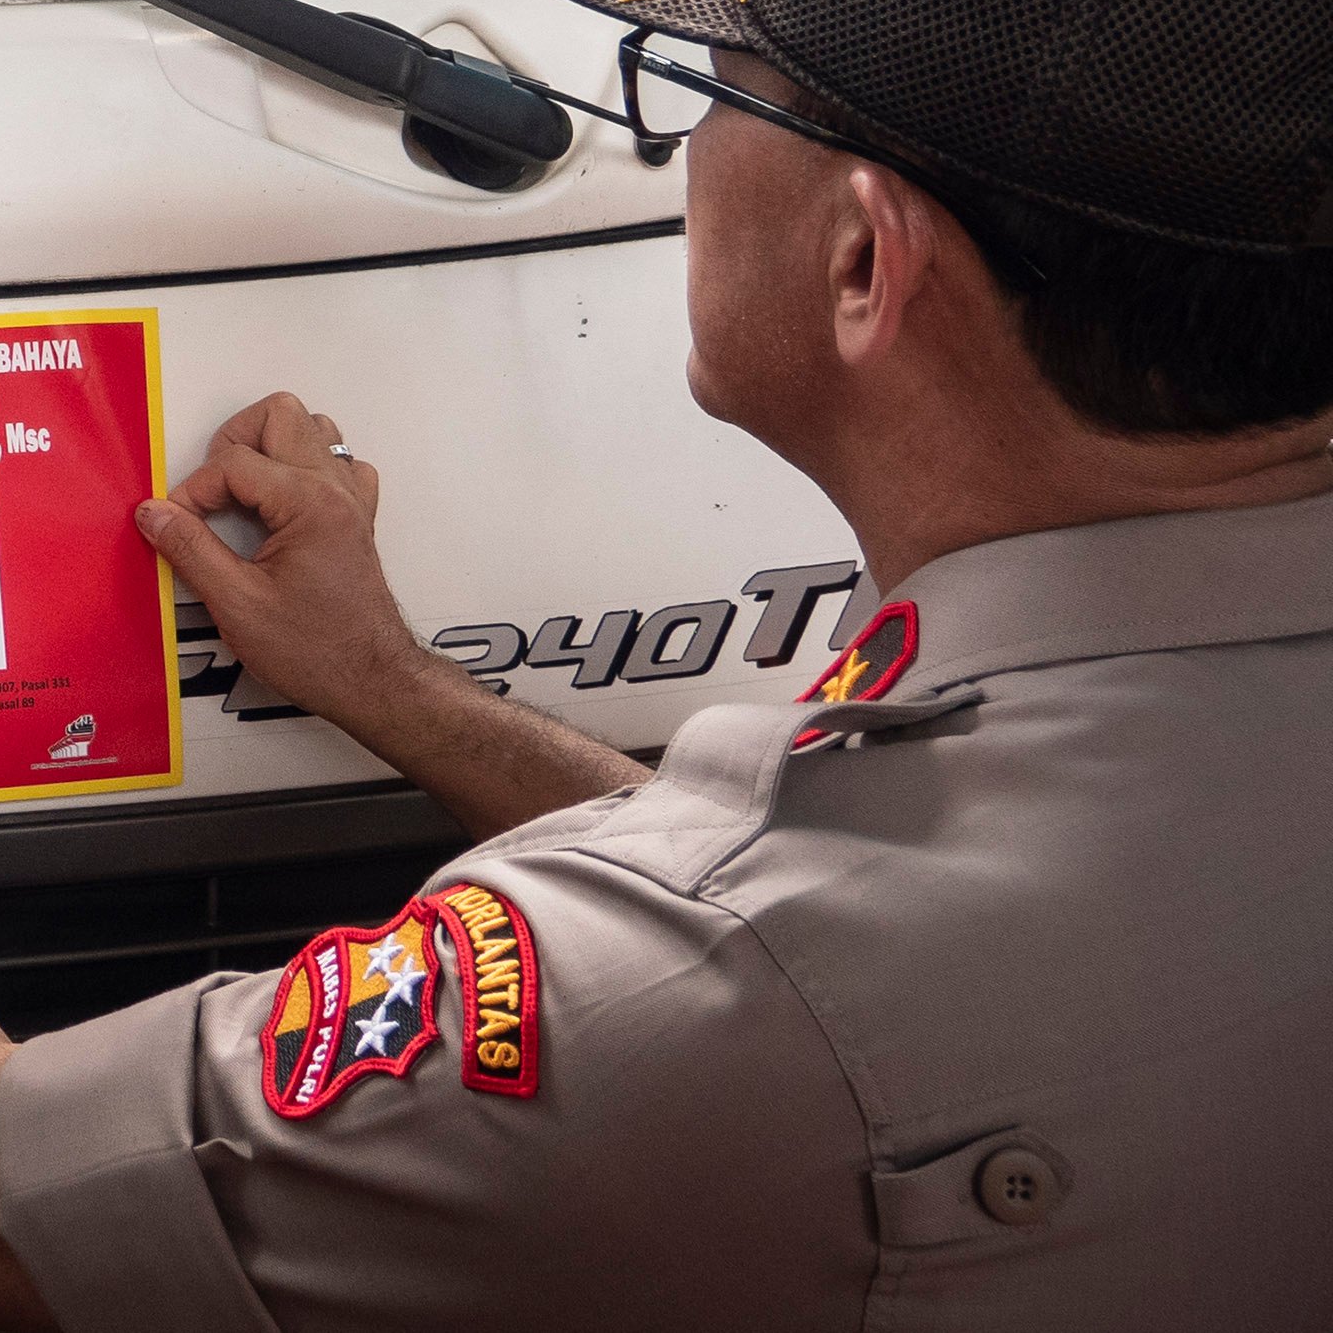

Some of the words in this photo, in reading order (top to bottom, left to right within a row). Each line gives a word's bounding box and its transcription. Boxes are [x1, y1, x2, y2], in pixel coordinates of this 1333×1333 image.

[5, 422, 51, 454] Msc
[21, 679, 49, 691] Pasal
[21, 697, 35, 708] 89
[315, 945, 342, 1020] MABES
[444, 886, 522, 1070] KORLANTAS
[294, 1025, 334, 1104] POLRI
